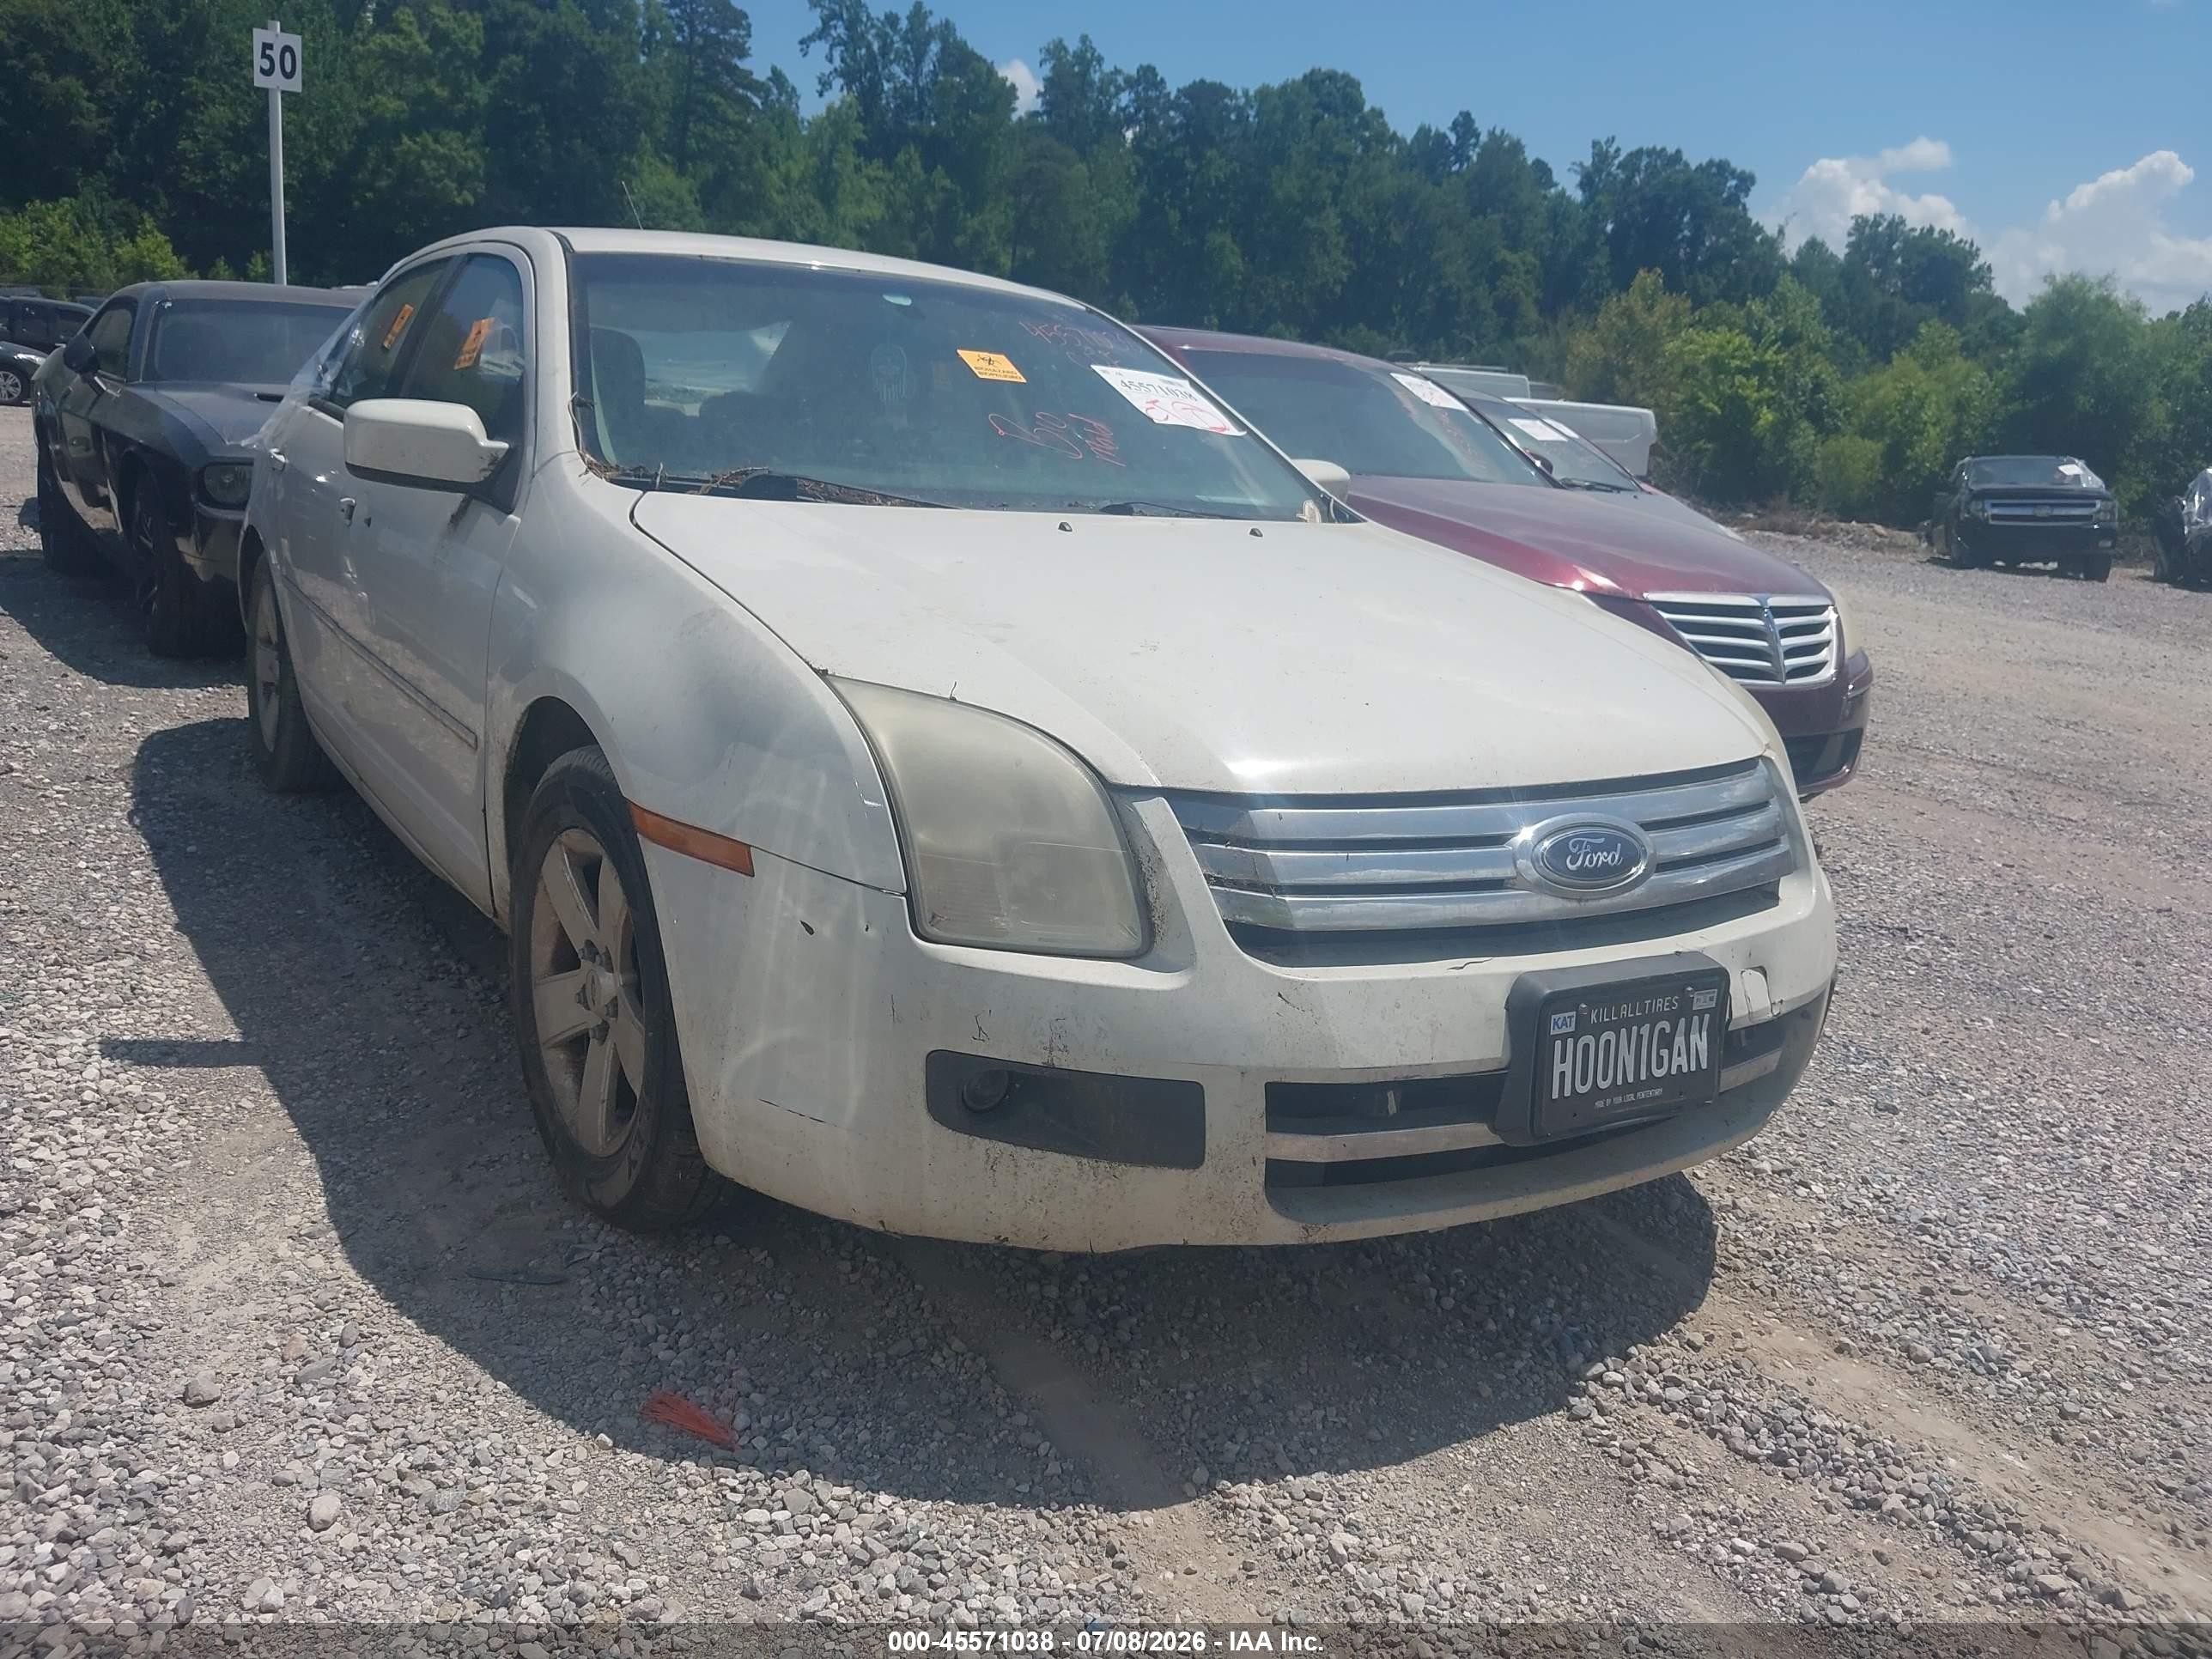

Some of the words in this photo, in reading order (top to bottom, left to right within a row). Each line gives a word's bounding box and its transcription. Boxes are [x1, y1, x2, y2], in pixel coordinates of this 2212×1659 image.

[259, 42, 297, 80] 50
[1120, 379, 1198, 402] 45571038
[1566, 837, 1623, 871] Ford
[1553, 1016, 1574, 1031] KAT
[1552, 1013, 1710, 1100] HOON1GAN
